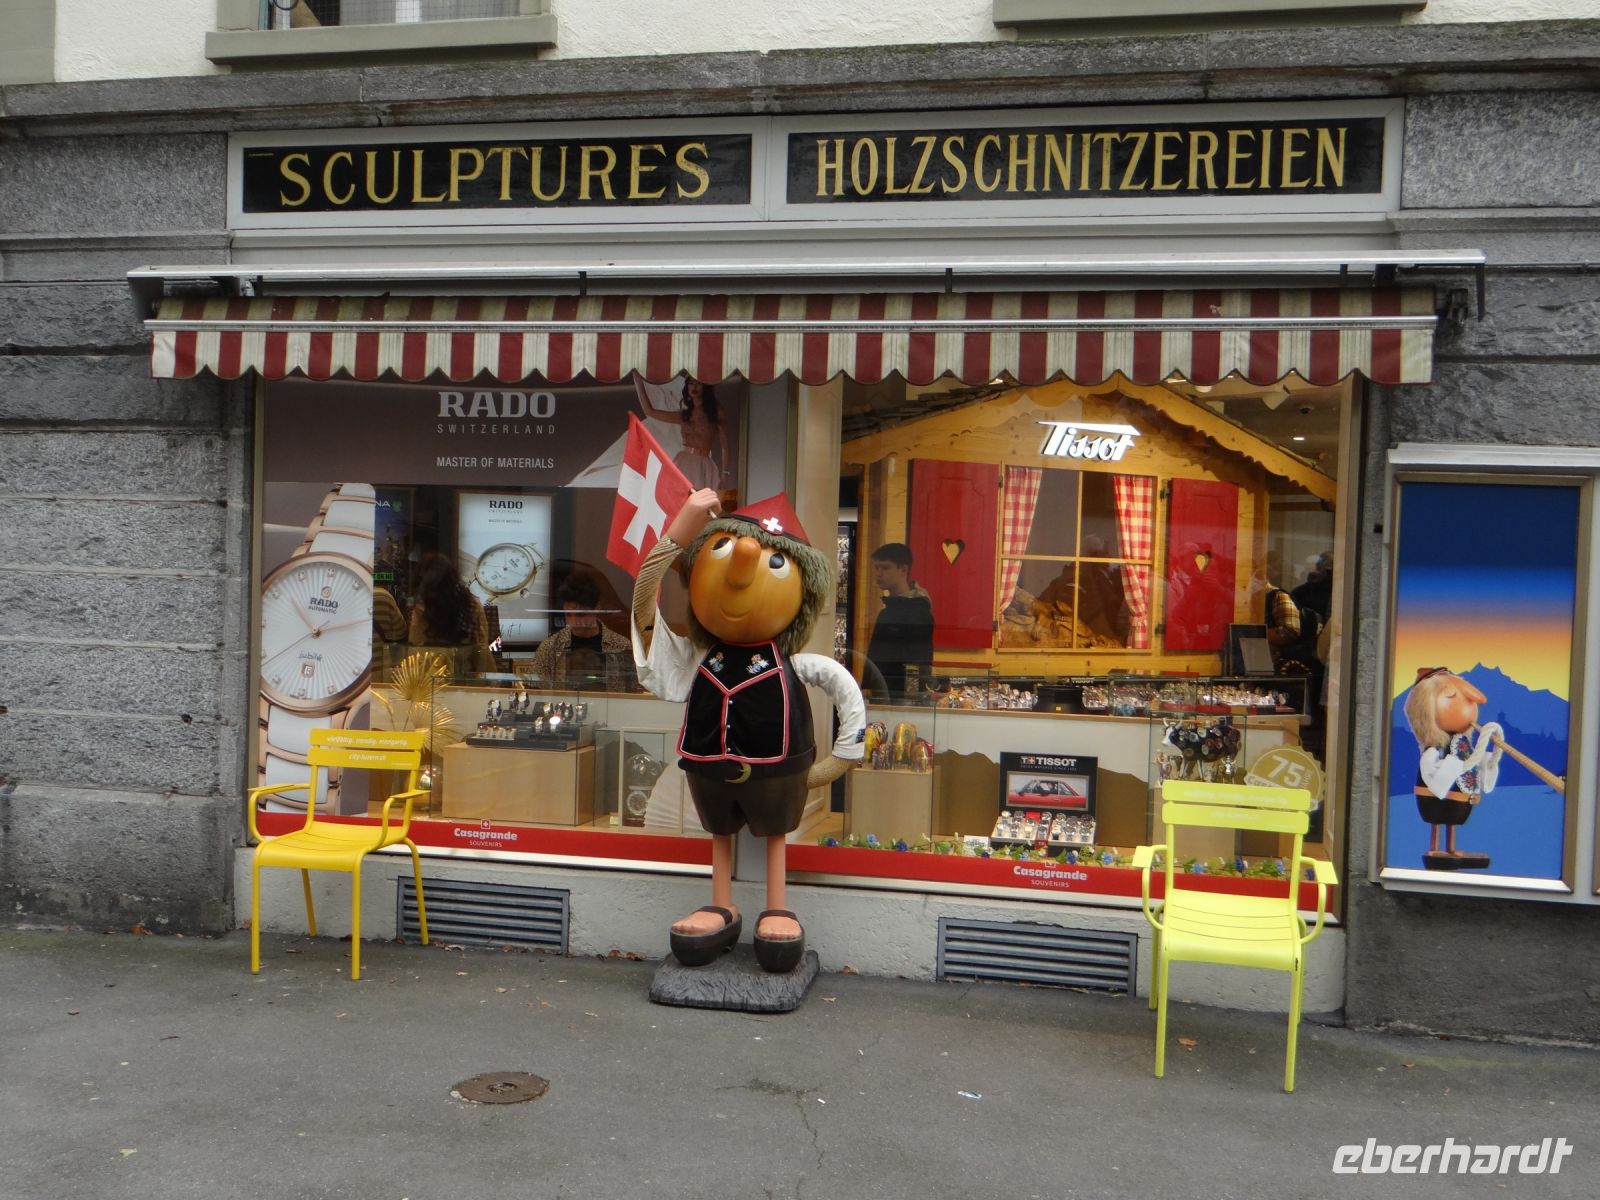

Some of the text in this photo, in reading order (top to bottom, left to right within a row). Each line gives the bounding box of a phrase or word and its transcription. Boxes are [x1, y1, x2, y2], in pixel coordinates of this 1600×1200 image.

[816, 127, 1348, 197] HOLZSCHNITZEREIEN
[280, 141, 710, 206] SCULPTURES
[437, 391, 556, 418] RADO
[437, 424, 555, 434] SWITZERLAND
[1036, 421, 1141, 462] Tissot
[436, 456, 554, 469] MASTER OF MATERIALS
[489, 500, 523, 509] RADO
[310, 597, 339, 609] RADO
[1037, 757, 1077, 767] TISSOT
[1268, 755, 1305, 787] 75
[454, 827, 518, 840] Casagrande
[469, 840, 503, 848] SOUVENIRS
[1013, 865, 1088, 880] Casagrande
[1031, 880, 1070, 888] SOUVENIRS
